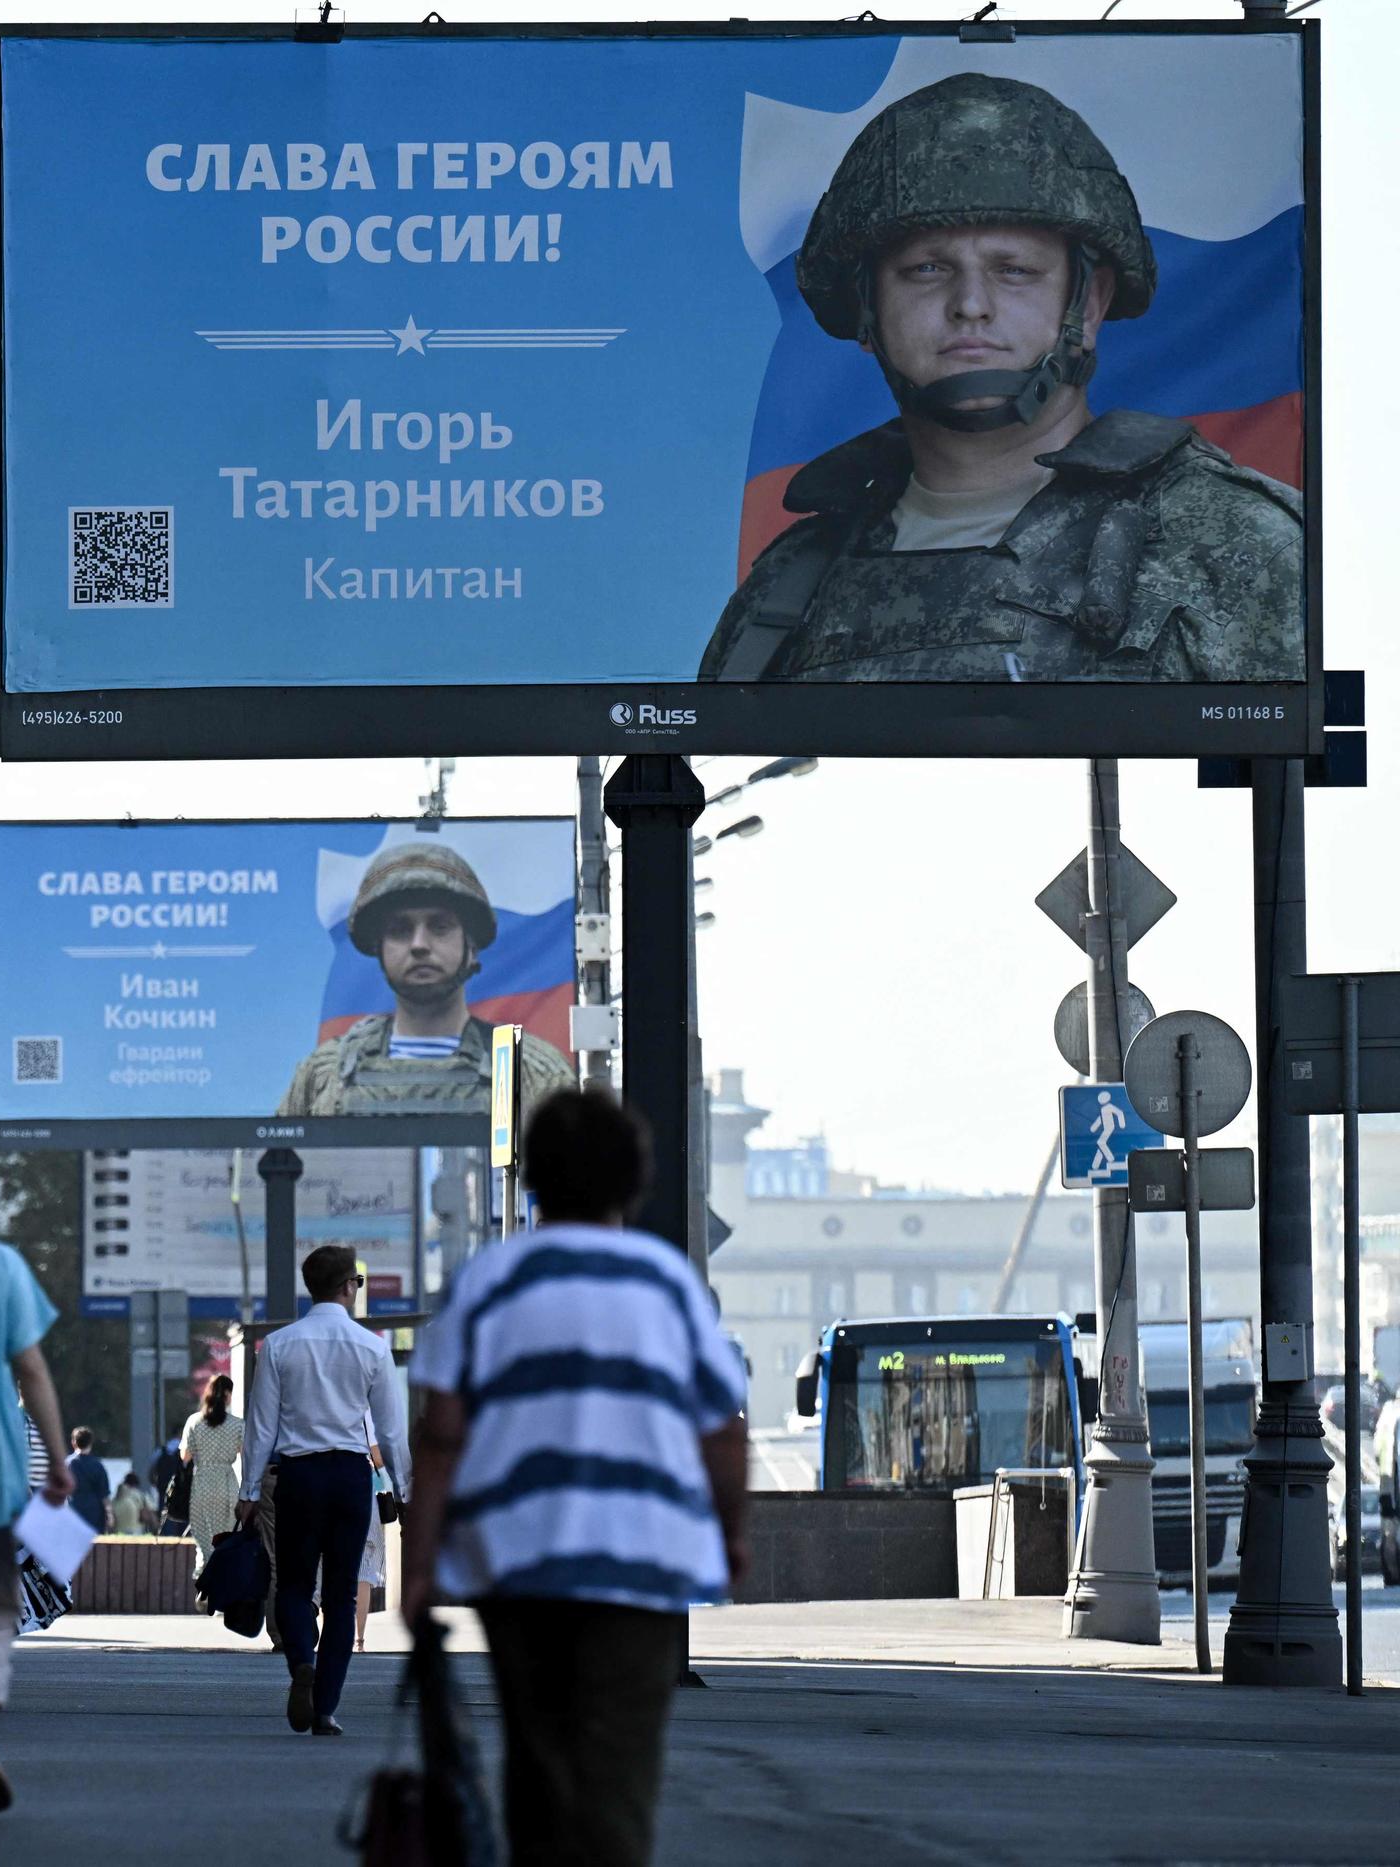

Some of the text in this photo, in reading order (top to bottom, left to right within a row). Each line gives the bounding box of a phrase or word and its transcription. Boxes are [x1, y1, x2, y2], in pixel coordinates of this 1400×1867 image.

[145, 141, 674, 193] СЛАВА ГЕРОЯМ
[261, 213, 562, 264] РОССИИ!
[316, 398, 513, 464] Игорь
[218, 466, 605, 532] Татарников
[304, 557, 522, 600] Капитан
[22, 710, 123, 726] (495)626-5200
[639, 704, 697, 725] Russ
[1202, 706, 1224, 719] MS
[1228, 706, 1271, 719] 01168
[39, 870, 279, 896] СЛАВА ГЕРОЯМ
[90, 903, 228, 928] РОССИИ!
[120, 973, 199, 999] Иван
[104, 1004, 217, 1029] Кочкин
[117, 1042, 203, 1065] Гвардии
[109, 1066, 212, 1088] ефрейтор
